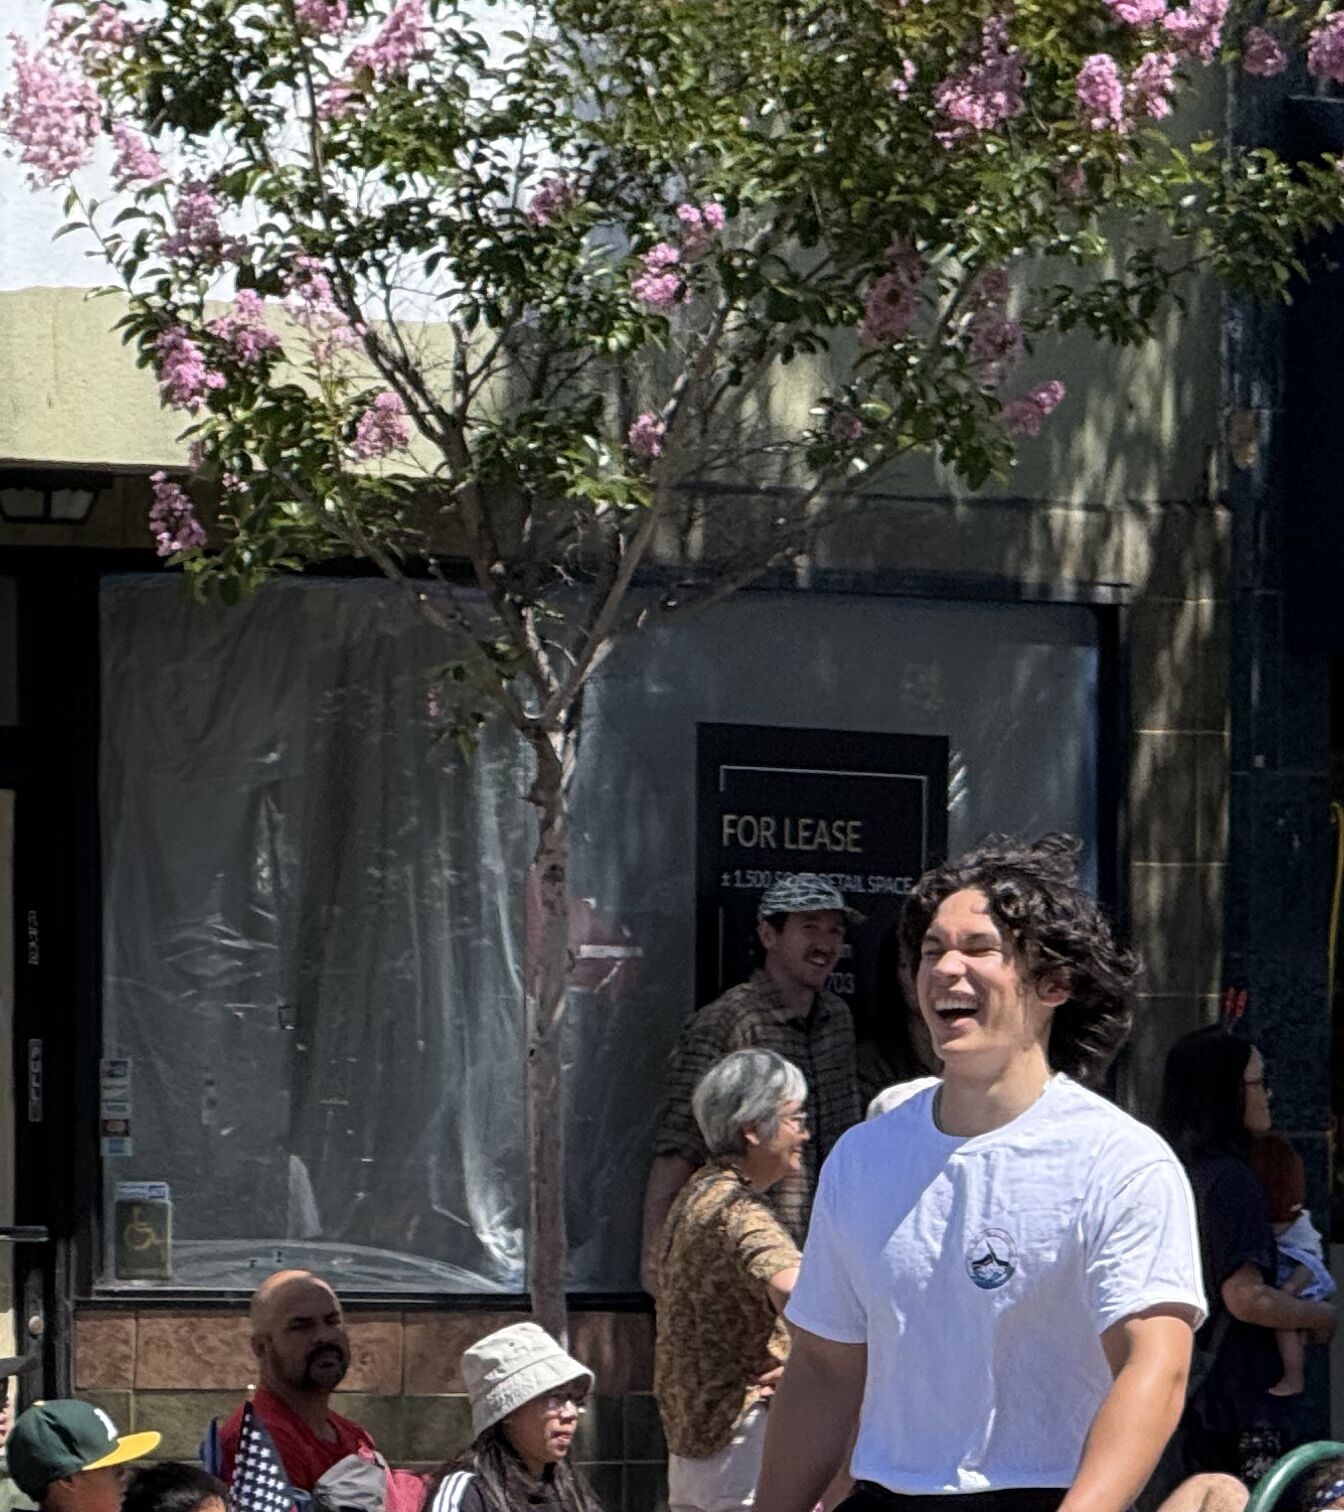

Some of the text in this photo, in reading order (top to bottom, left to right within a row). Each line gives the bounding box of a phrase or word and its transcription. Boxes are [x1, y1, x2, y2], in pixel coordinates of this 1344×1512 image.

[721, 814, 863, 854] FOR LEASE
[867, 875, 913, 895] SPACE
